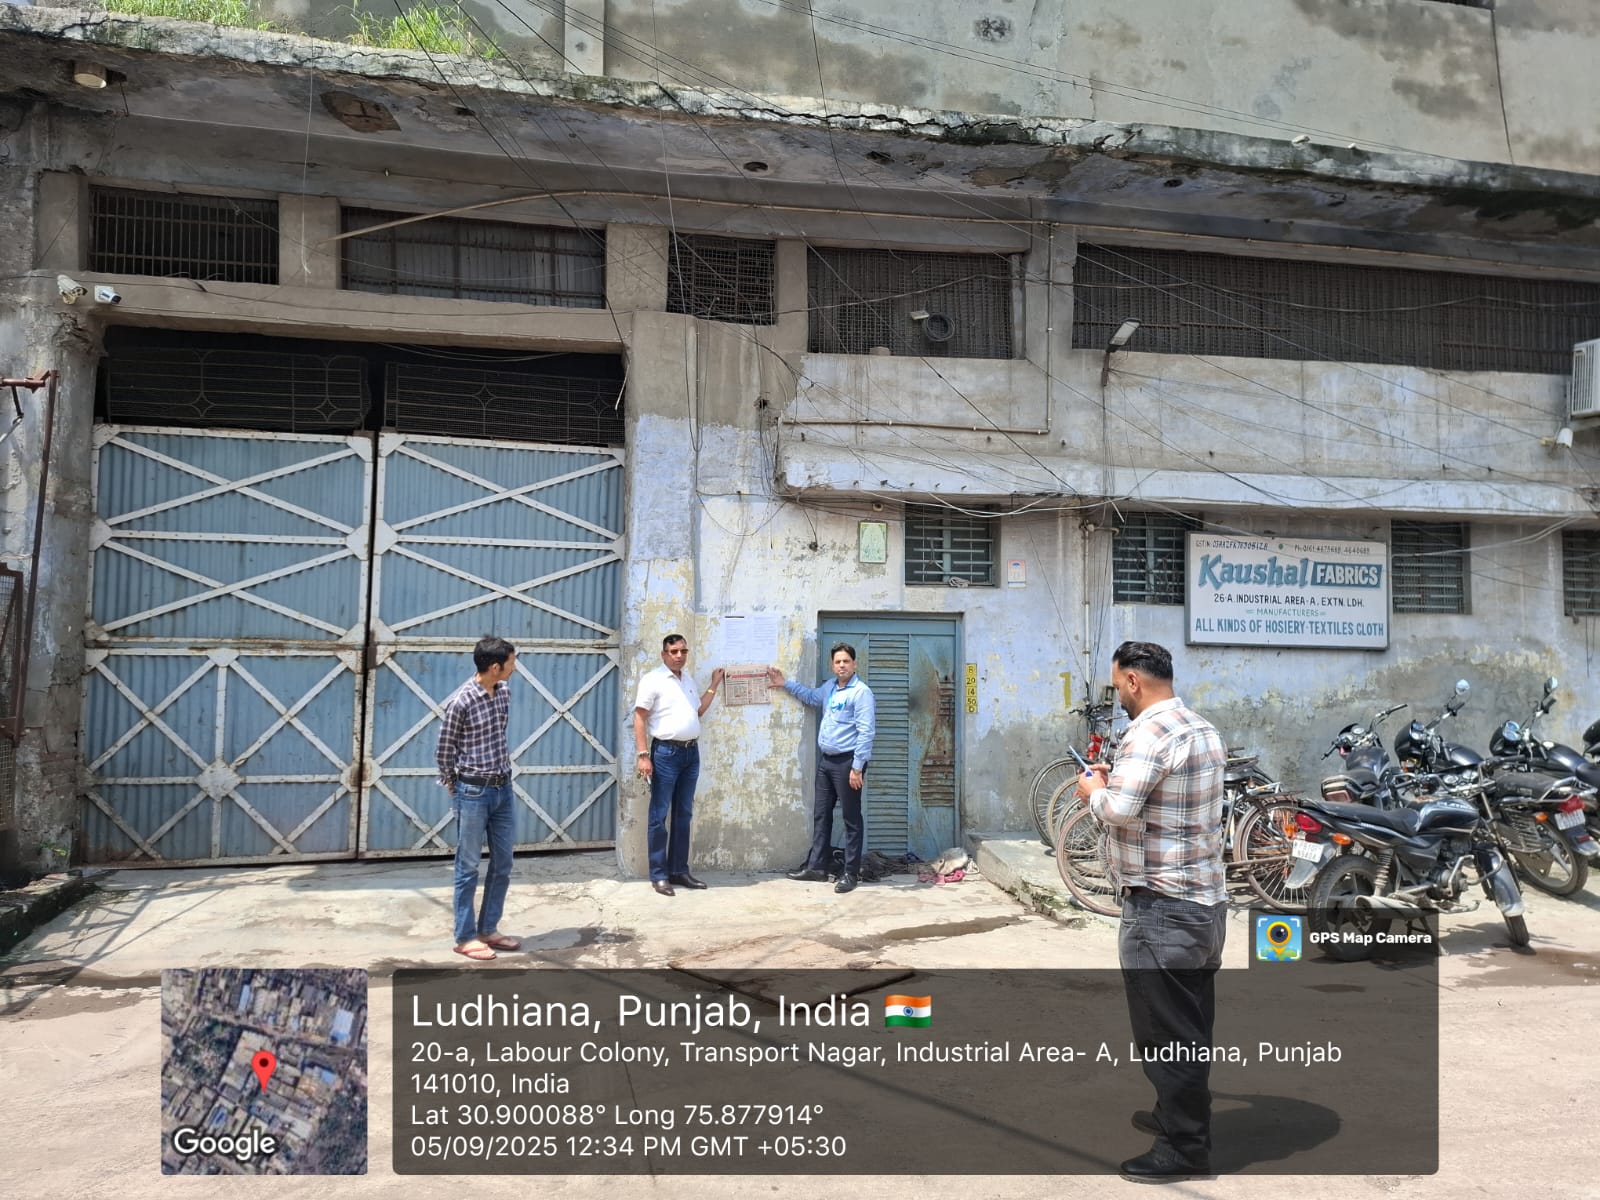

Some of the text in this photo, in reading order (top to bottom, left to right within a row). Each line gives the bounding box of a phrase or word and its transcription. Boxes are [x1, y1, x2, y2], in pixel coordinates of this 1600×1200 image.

[1198, 553, 1379, 591] Kaushal FABRICS
[1236, 594, 1282, 605] INDUSTRIAL
[1256, 608, 1319, 617] MANUFACTURERS
[1195, 618, 1215, 632] ALL
[1217, 618, 1247, 633] KINDS
[1249, 619, 1263, 634] OF
[1356, 622, 1384, 637] CLOTH
